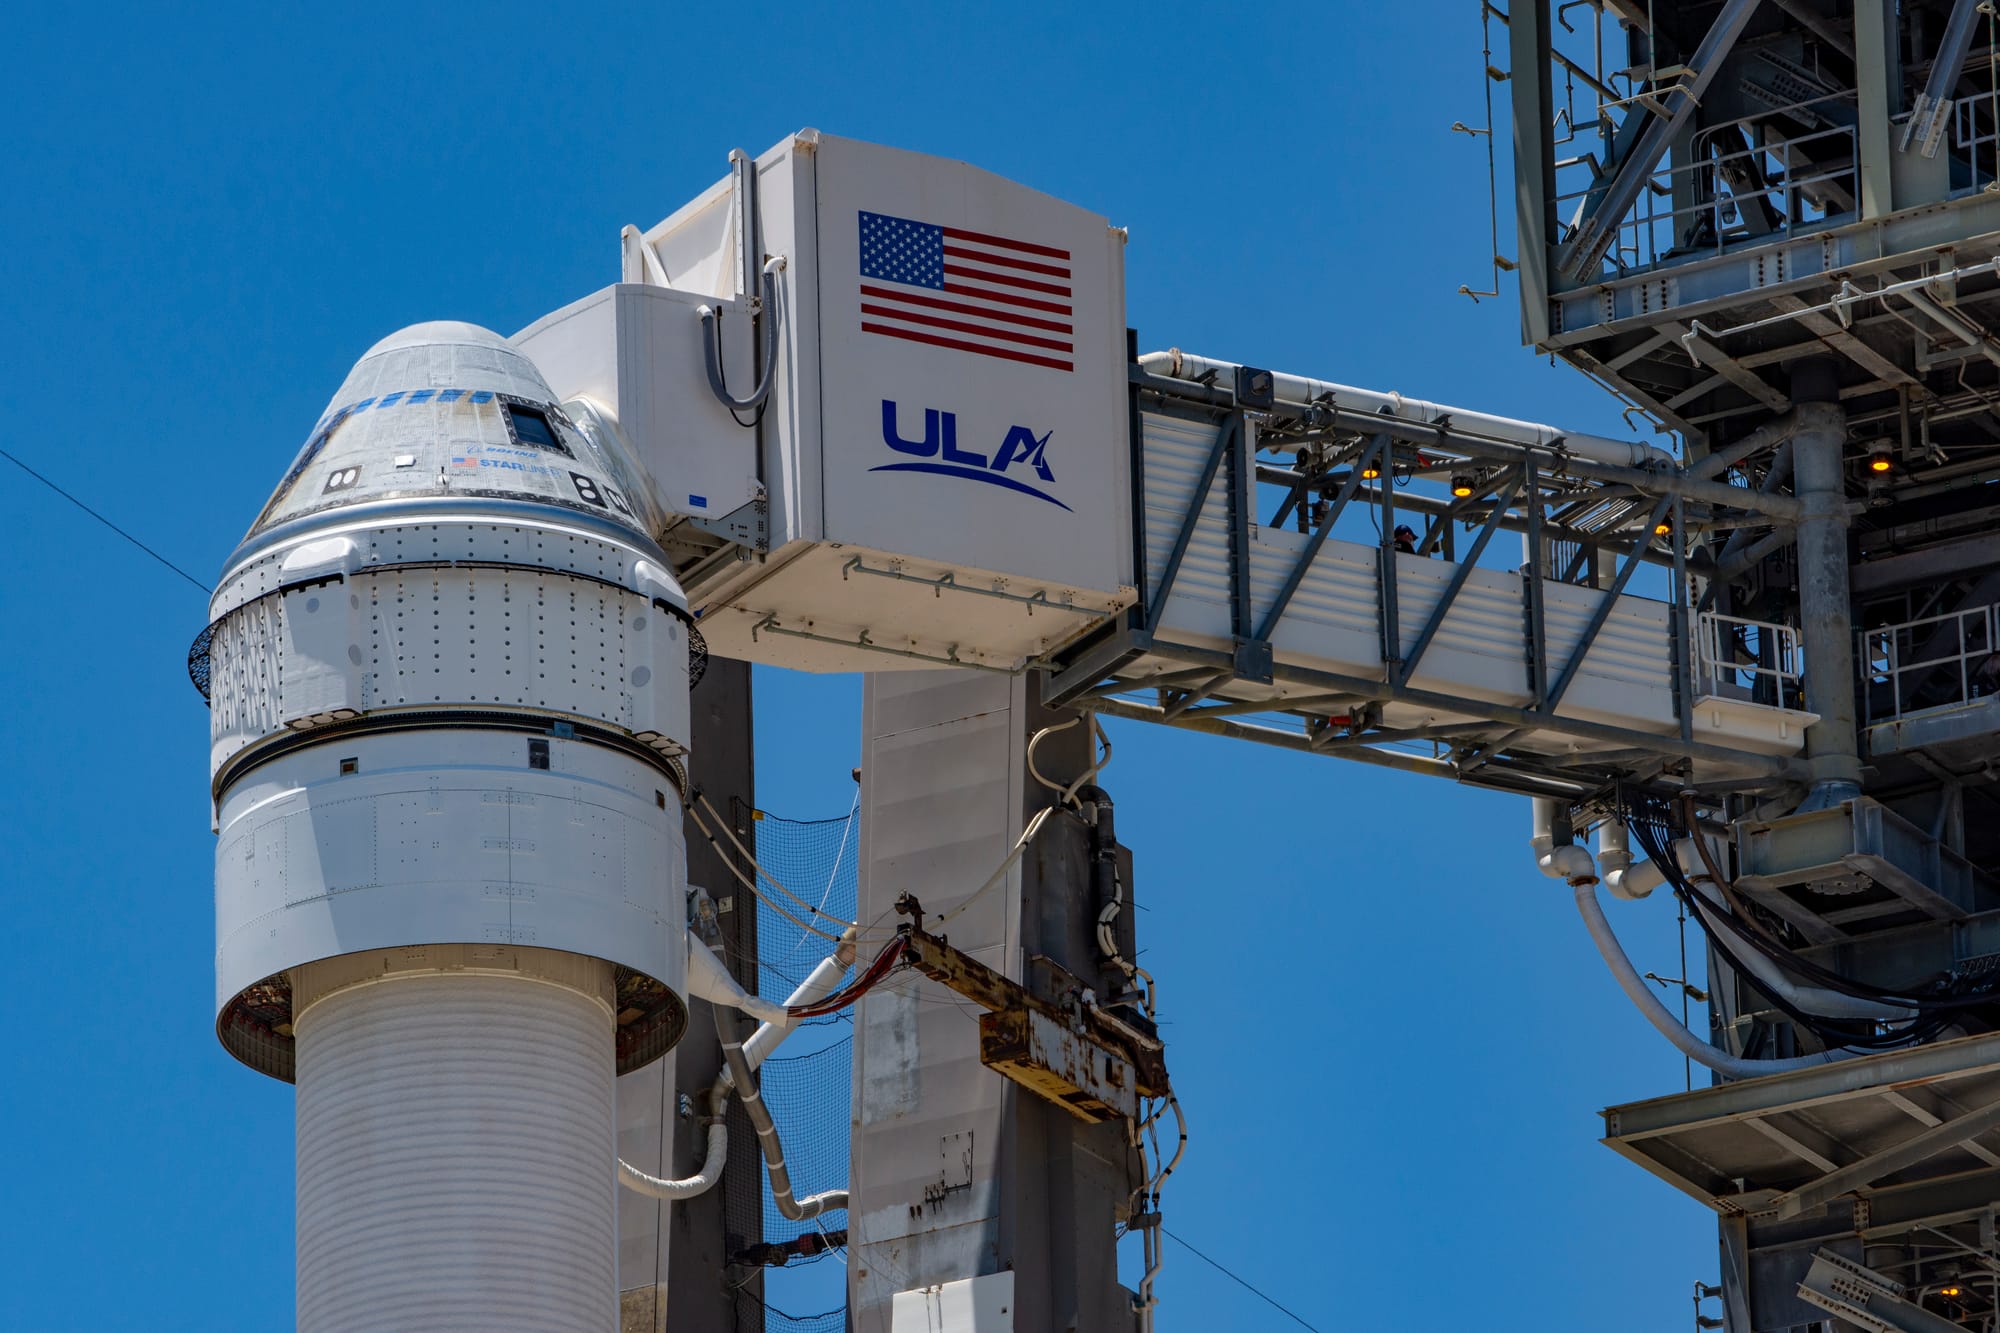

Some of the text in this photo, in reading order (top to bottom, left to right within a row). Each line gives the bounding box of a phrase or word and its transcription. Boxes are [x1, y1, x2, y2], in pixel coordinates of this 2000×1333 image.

[881, 399, 1056, 483] ULA
[486, 447, 538, 458] BOEING
[480, 459, 561, 477] STARLINER
